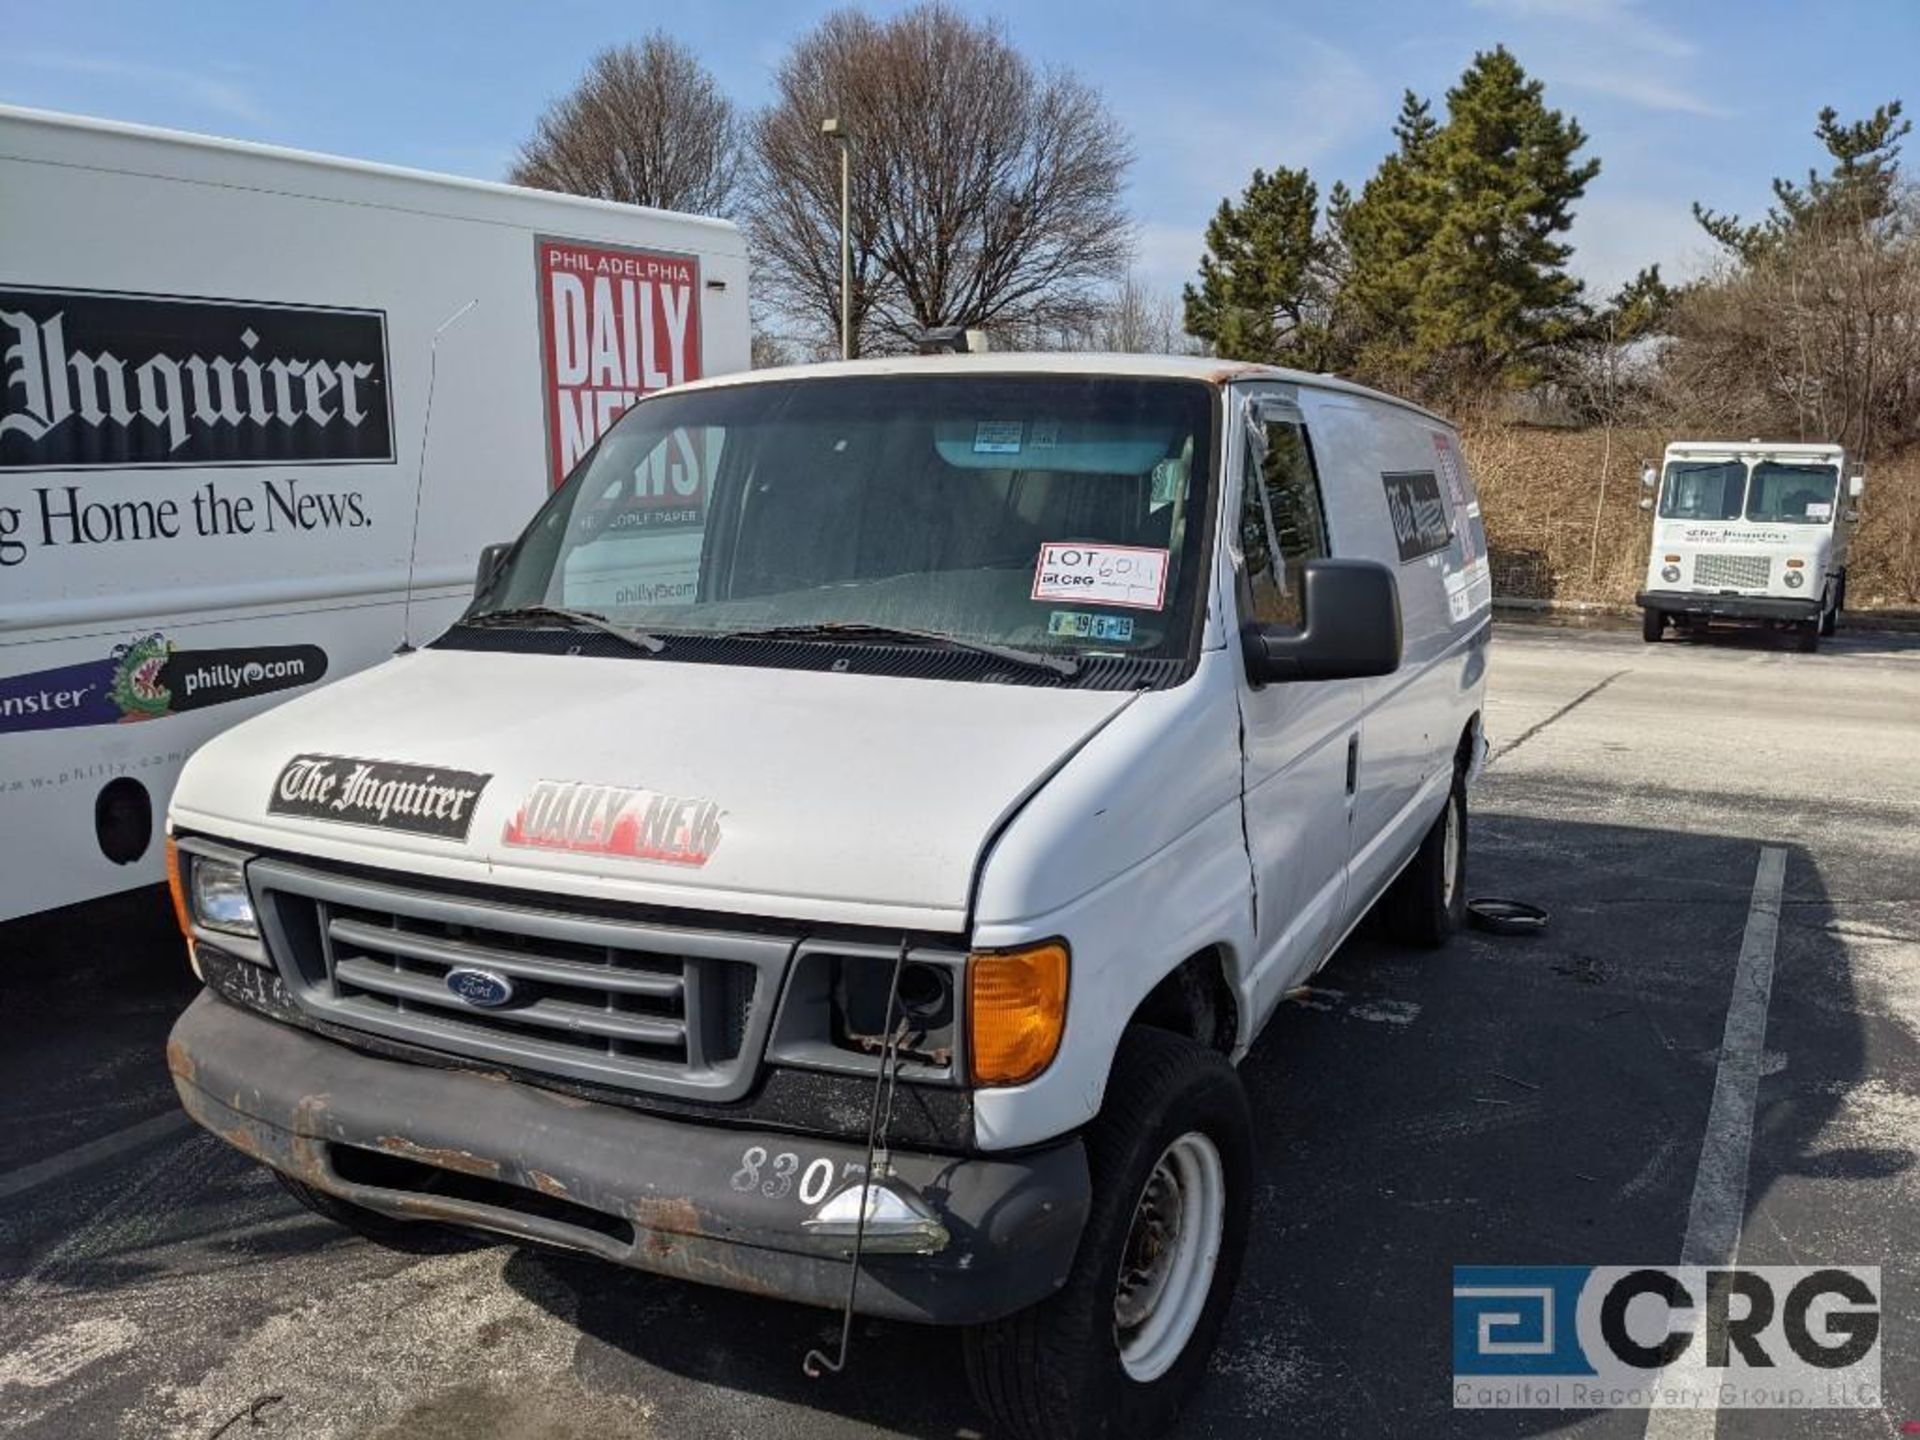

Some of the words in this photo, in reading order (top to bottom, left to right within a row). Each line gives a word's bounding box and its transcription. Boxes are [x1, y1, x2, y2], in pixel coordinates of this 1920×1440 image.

[550, 249, 690, 282] PHILADELPHIA
[551, 271, 691, 389] DAILY
[32, 486, 180, 546] Home
[191, 482, 255, 536] the
[262, 478, 373, 532] News.
[1047, 550, 1099, 567] LOT
[1061, 574, 1095, 586] CRG
[280, 759, 337, 804] The
[329, 763, 476, 822] Inquirer
[525, 782, 640, 843] DAILY
